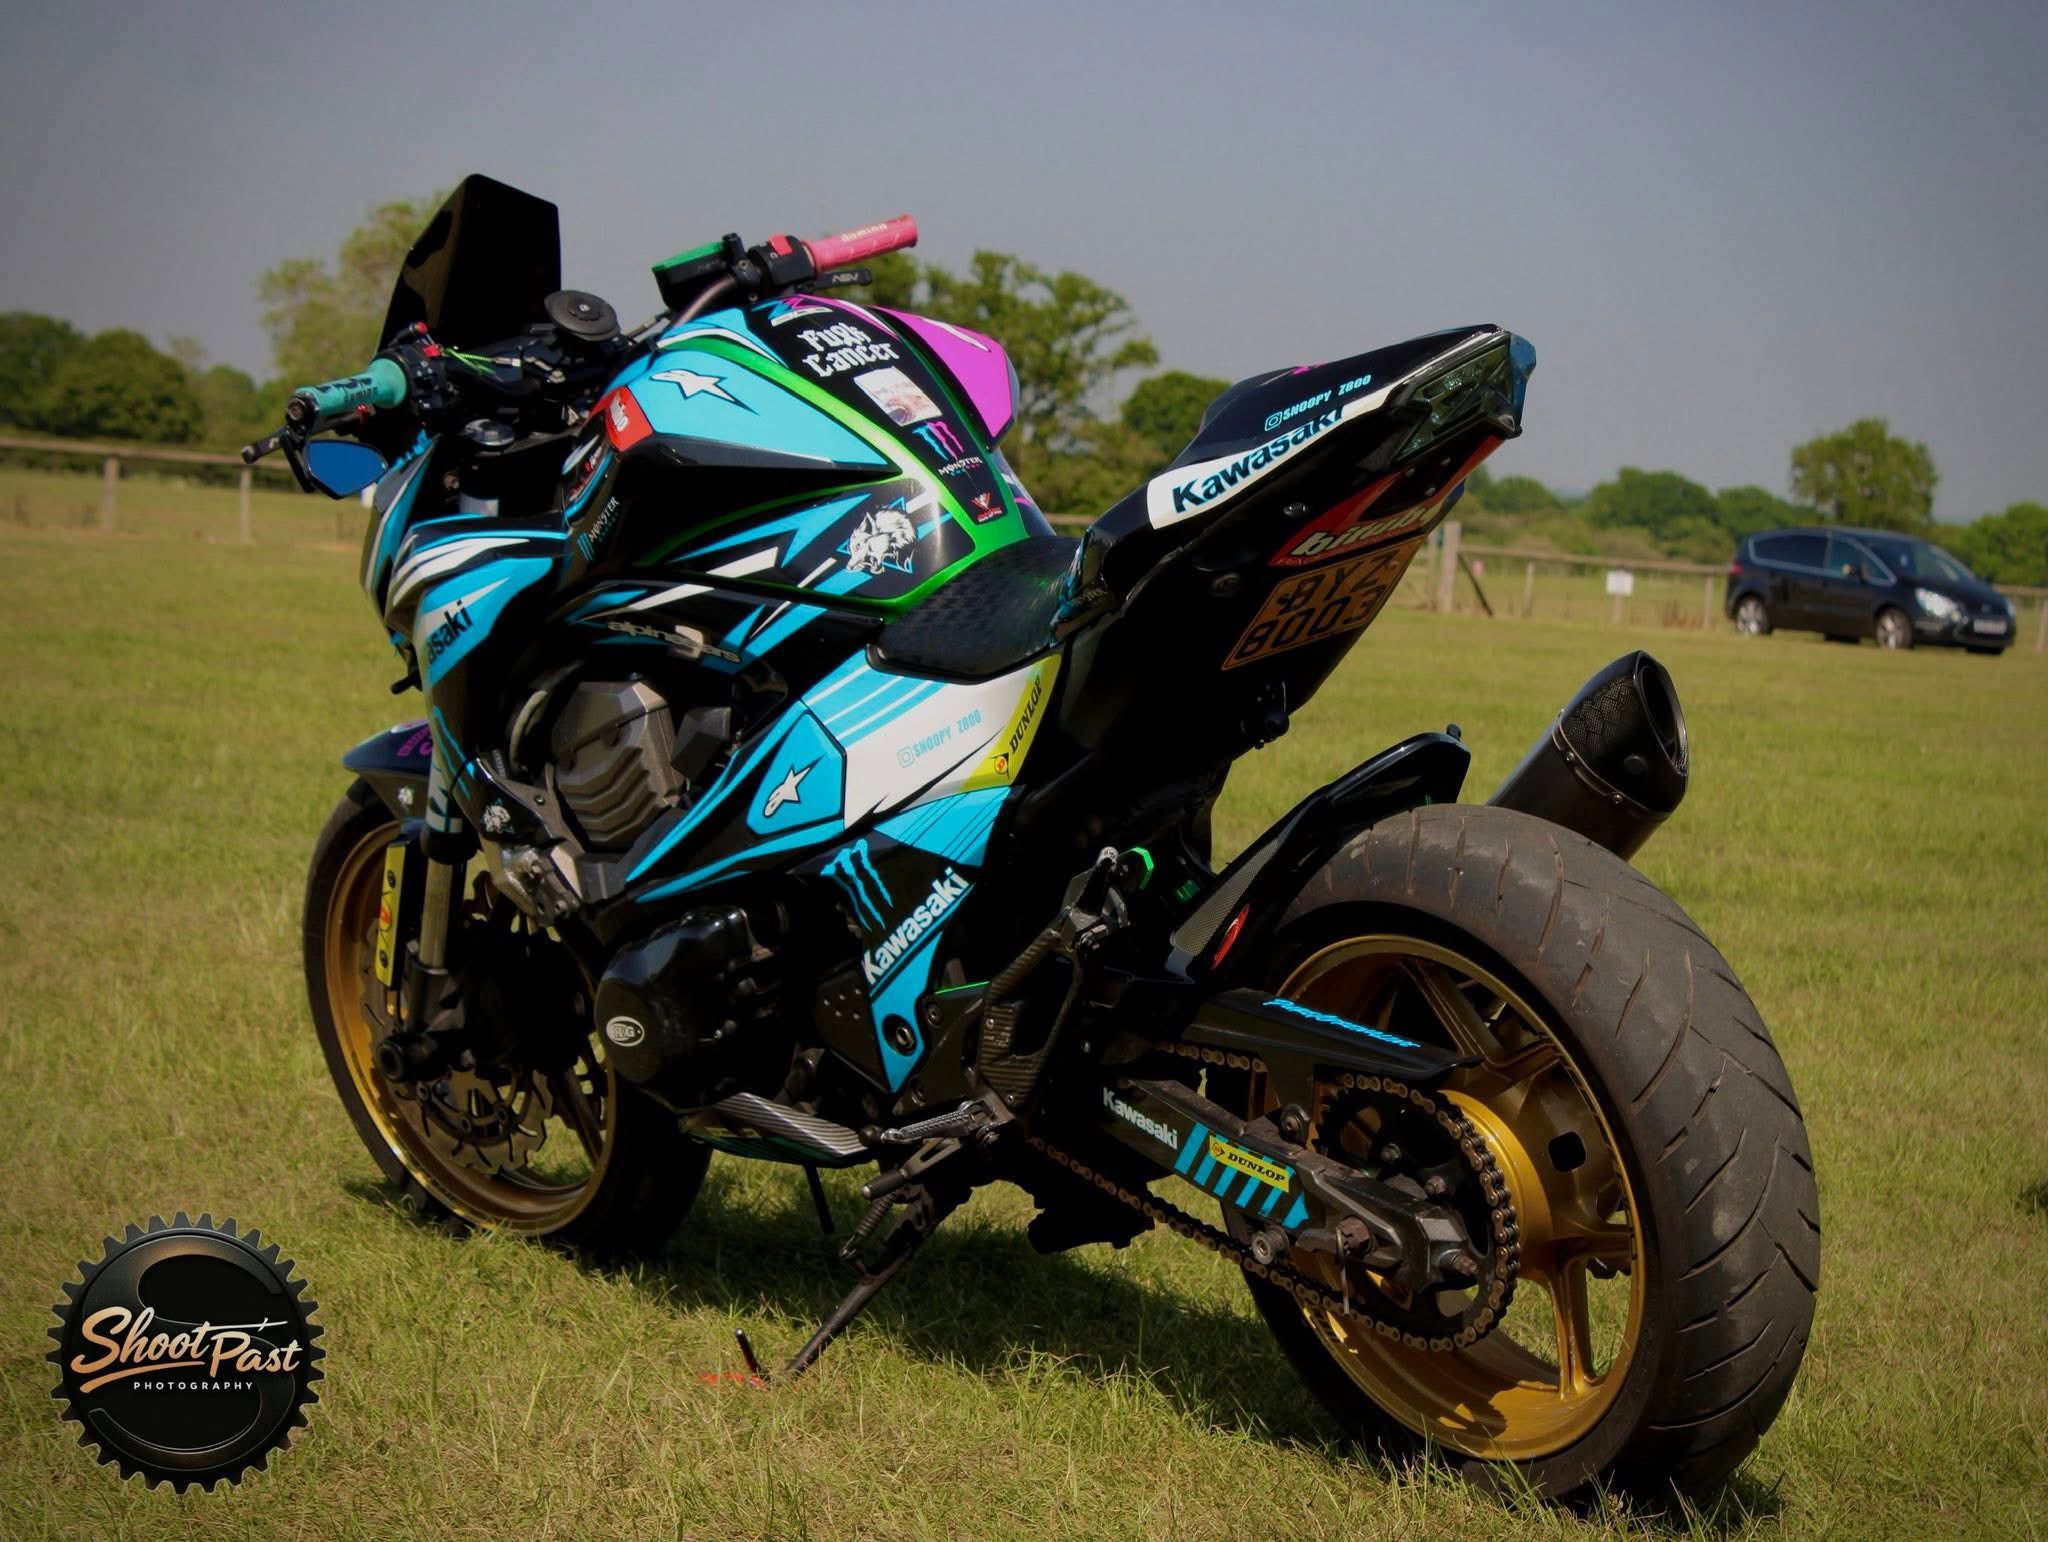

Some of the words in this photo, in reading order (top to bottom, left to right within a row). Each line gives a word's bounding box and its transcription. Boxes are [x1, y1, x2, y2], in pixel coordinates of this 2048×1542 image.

[1282, 390, 1332, 421] SNOOPY
[1338, 374, 1371, 396] Z800
[938, 456, 982, 475] MONSTER
[1172, 405, 1345, 513] Kawasaki
[1008, 675, 1042, 754] DUNLOP
[913, 728, 951, 758] SNOOPY
[862, 867, 970, 985] Kawasaki
[1103, 1087, 1178, 1150] Kawasaki
[1228, 1152, 1286, 1181] DUNLOP
